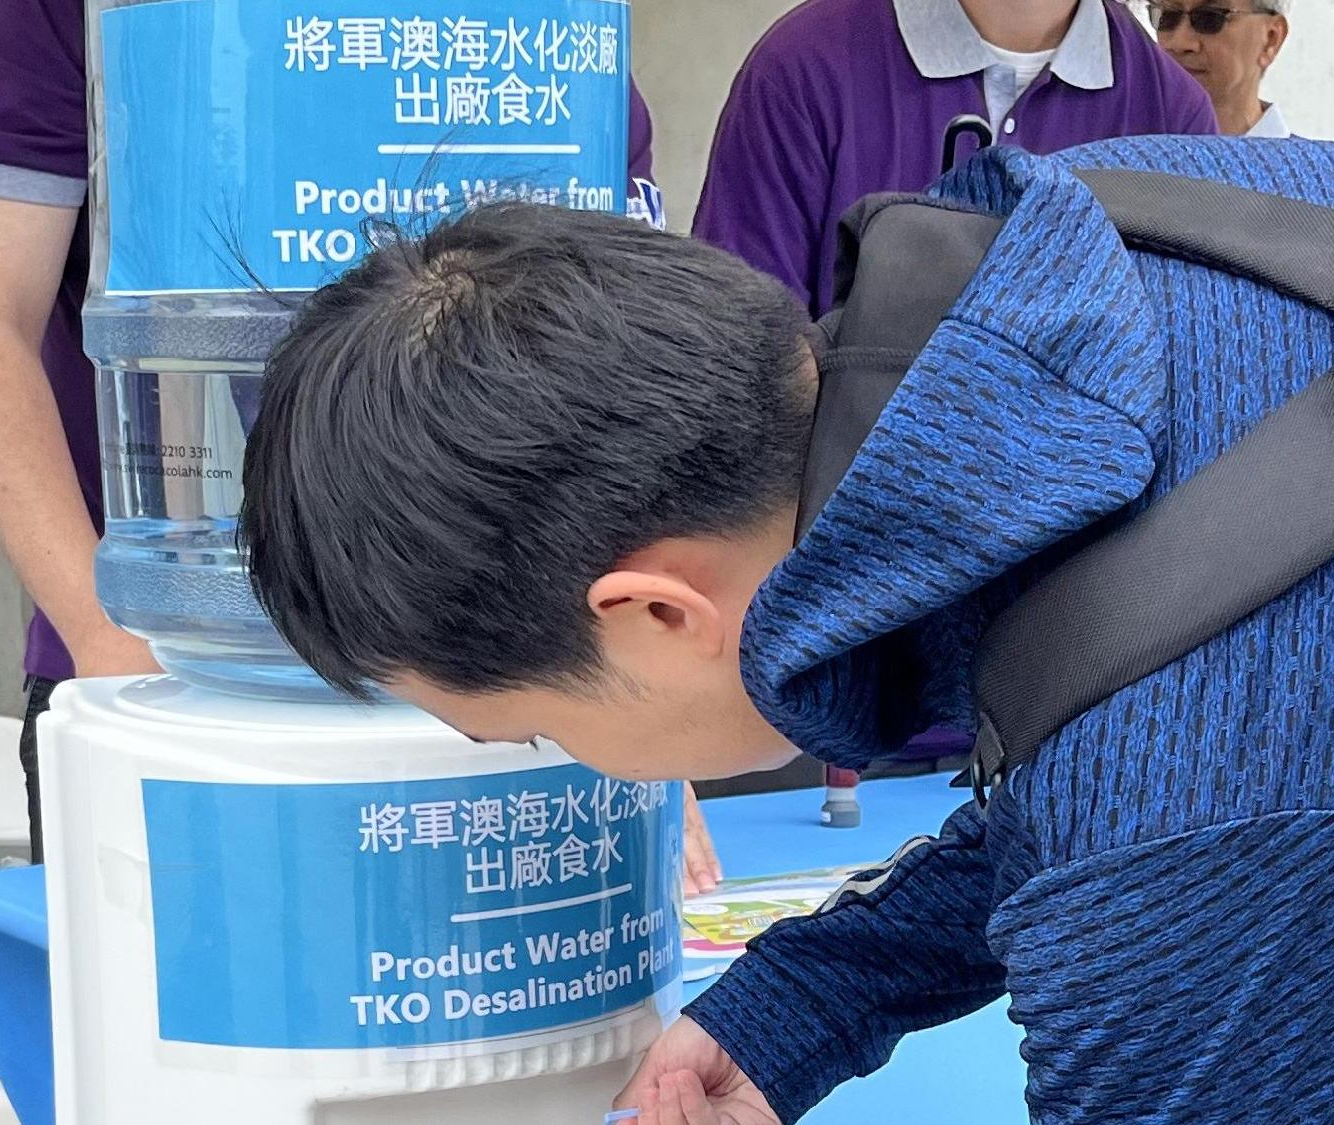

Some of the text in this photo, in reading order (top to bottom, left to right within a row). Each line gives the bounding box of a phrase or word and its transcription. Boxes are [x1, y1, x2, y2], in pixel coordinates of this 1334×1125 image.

[283, 15, 619, 75] 將軍澳海水化淡廠
[395, 72, 572, 126] 出廠食水
[294, 178, 451, 214] Product
[567, 176, 614, 212] from
[272, 228, 357, 263] TKO
[189, 445, 213, 459] 3311
[466, 826, 624, 894] 出廠食水
[370, 908, 665, 983] Product Water from
[349, 942, 675, 1027] TKO Desalination Plant
